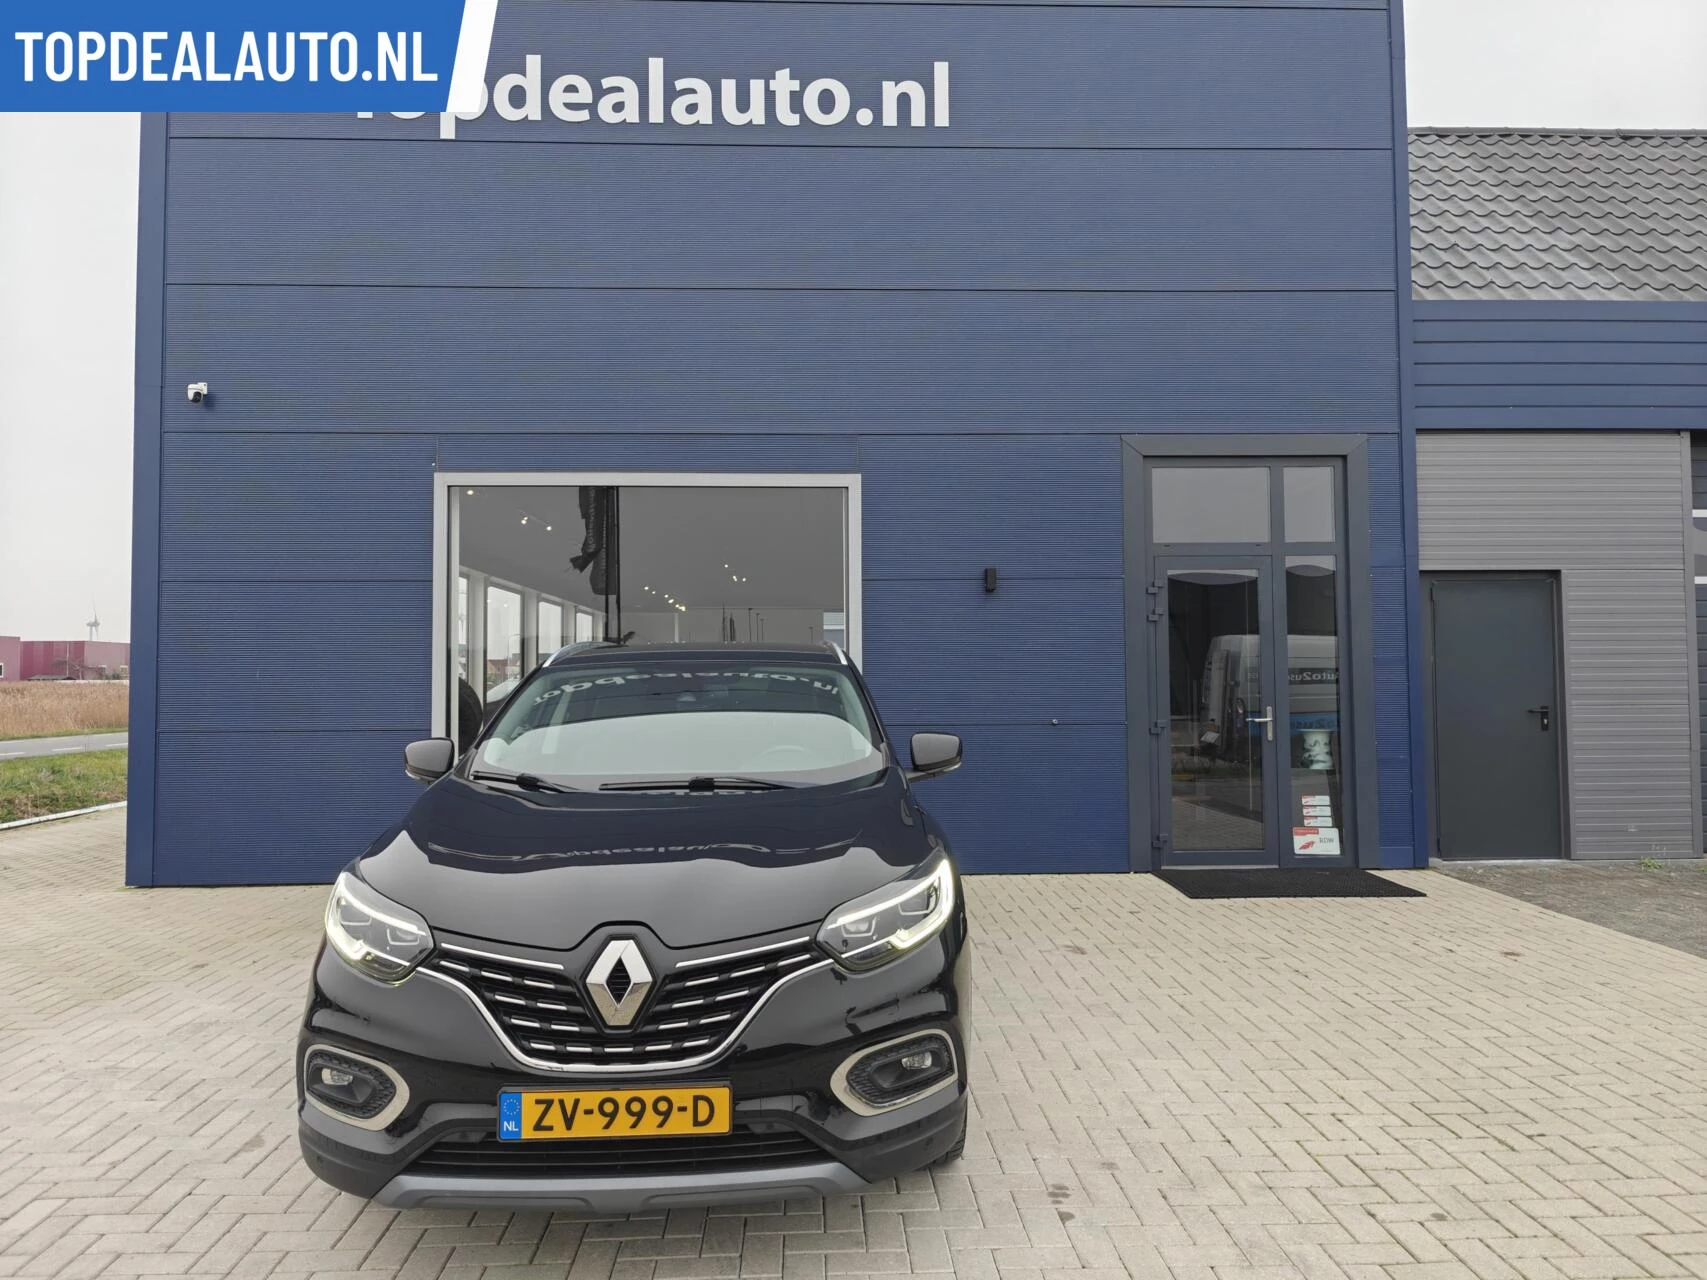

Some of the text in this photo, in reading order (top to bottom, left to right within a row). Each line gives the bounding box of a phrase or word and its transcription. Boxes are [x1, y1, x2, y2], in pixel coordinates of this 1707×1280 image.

[356, 54, 952, 140] dealauto.nl
[503, 1121, 519, 1132] NL
[532, 1094, 716, 1132] ZV-999-D
